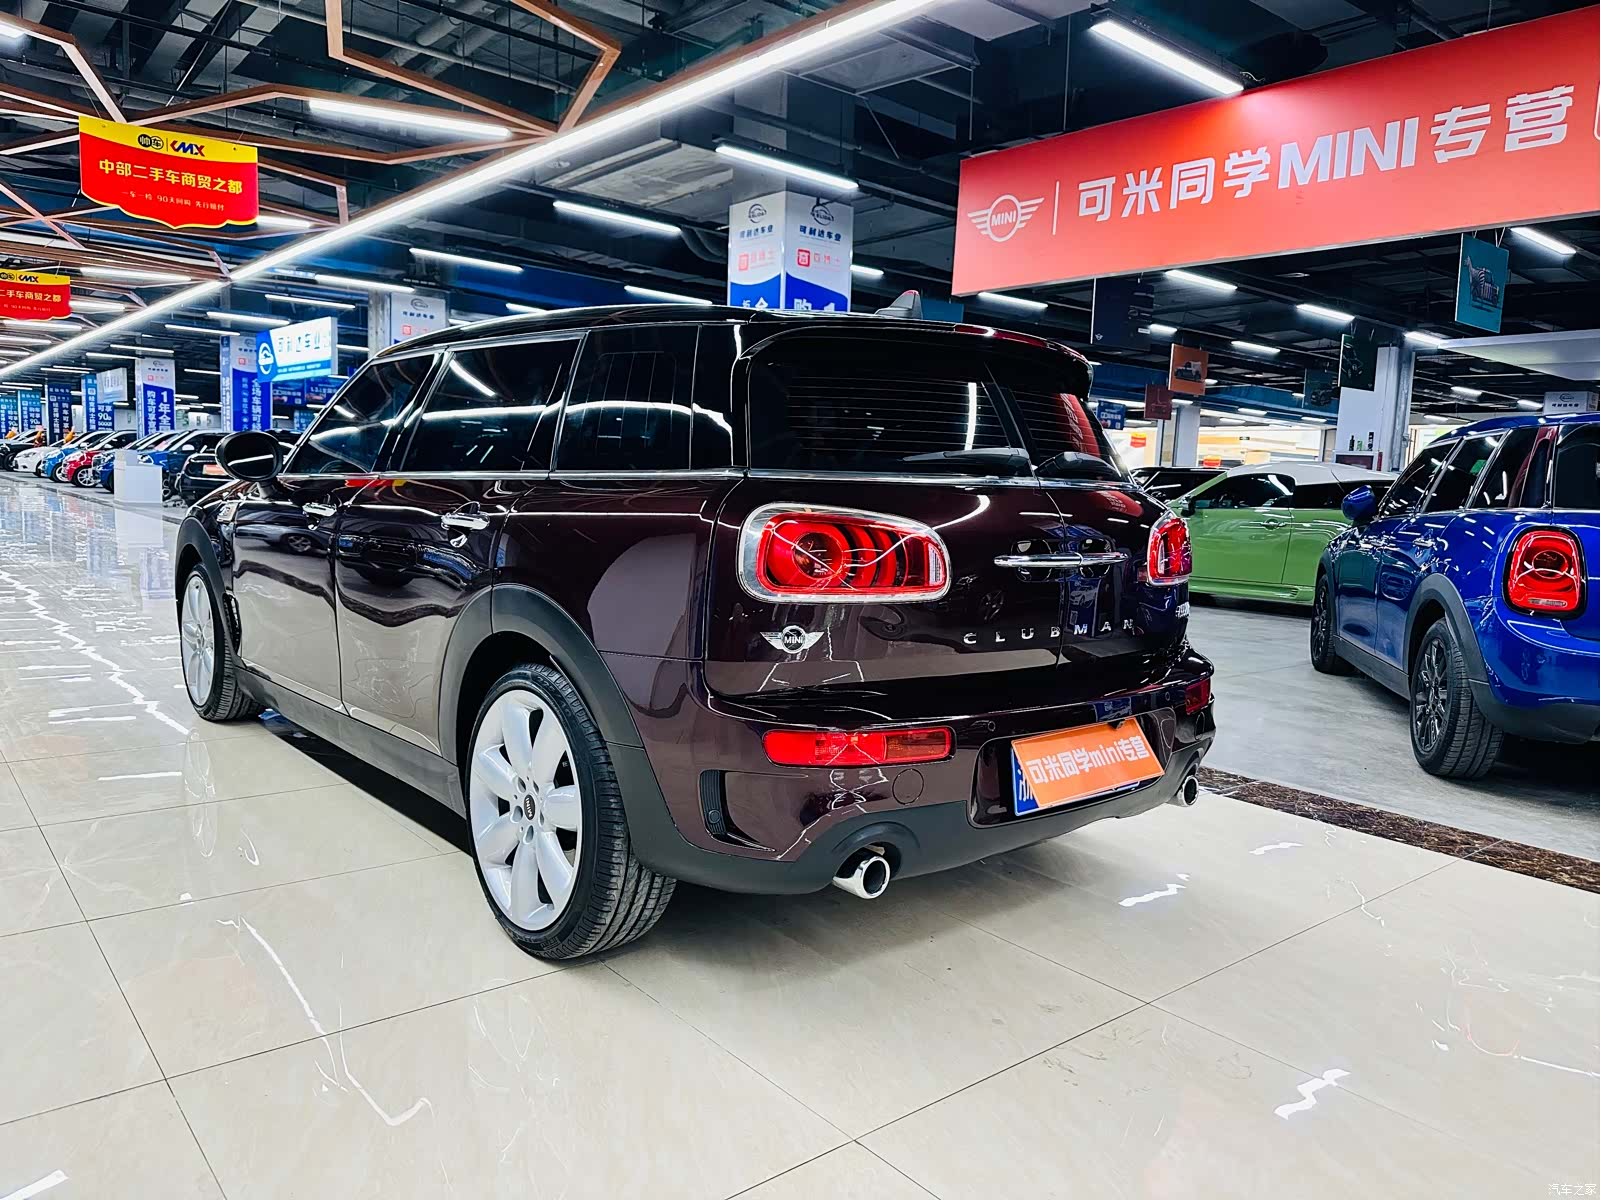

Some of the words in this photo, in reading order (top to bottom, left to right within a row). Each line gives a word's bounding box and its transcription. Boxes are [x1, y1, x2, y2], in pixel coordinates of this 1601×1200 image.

[1078, 85, 1575, 222] 可米同学MINI专营
[99, 159, 243, 195] 中部二手车商贸之都
[990, 211, 1017, 225] MINI
[799, 224, 842, 241] 可利达车业
[963, 618, 1134, 645] CLUBMAN
[1025, 735, 1150, 785] 可米同学mini专营
[525, 797, 533, 818] MINI
